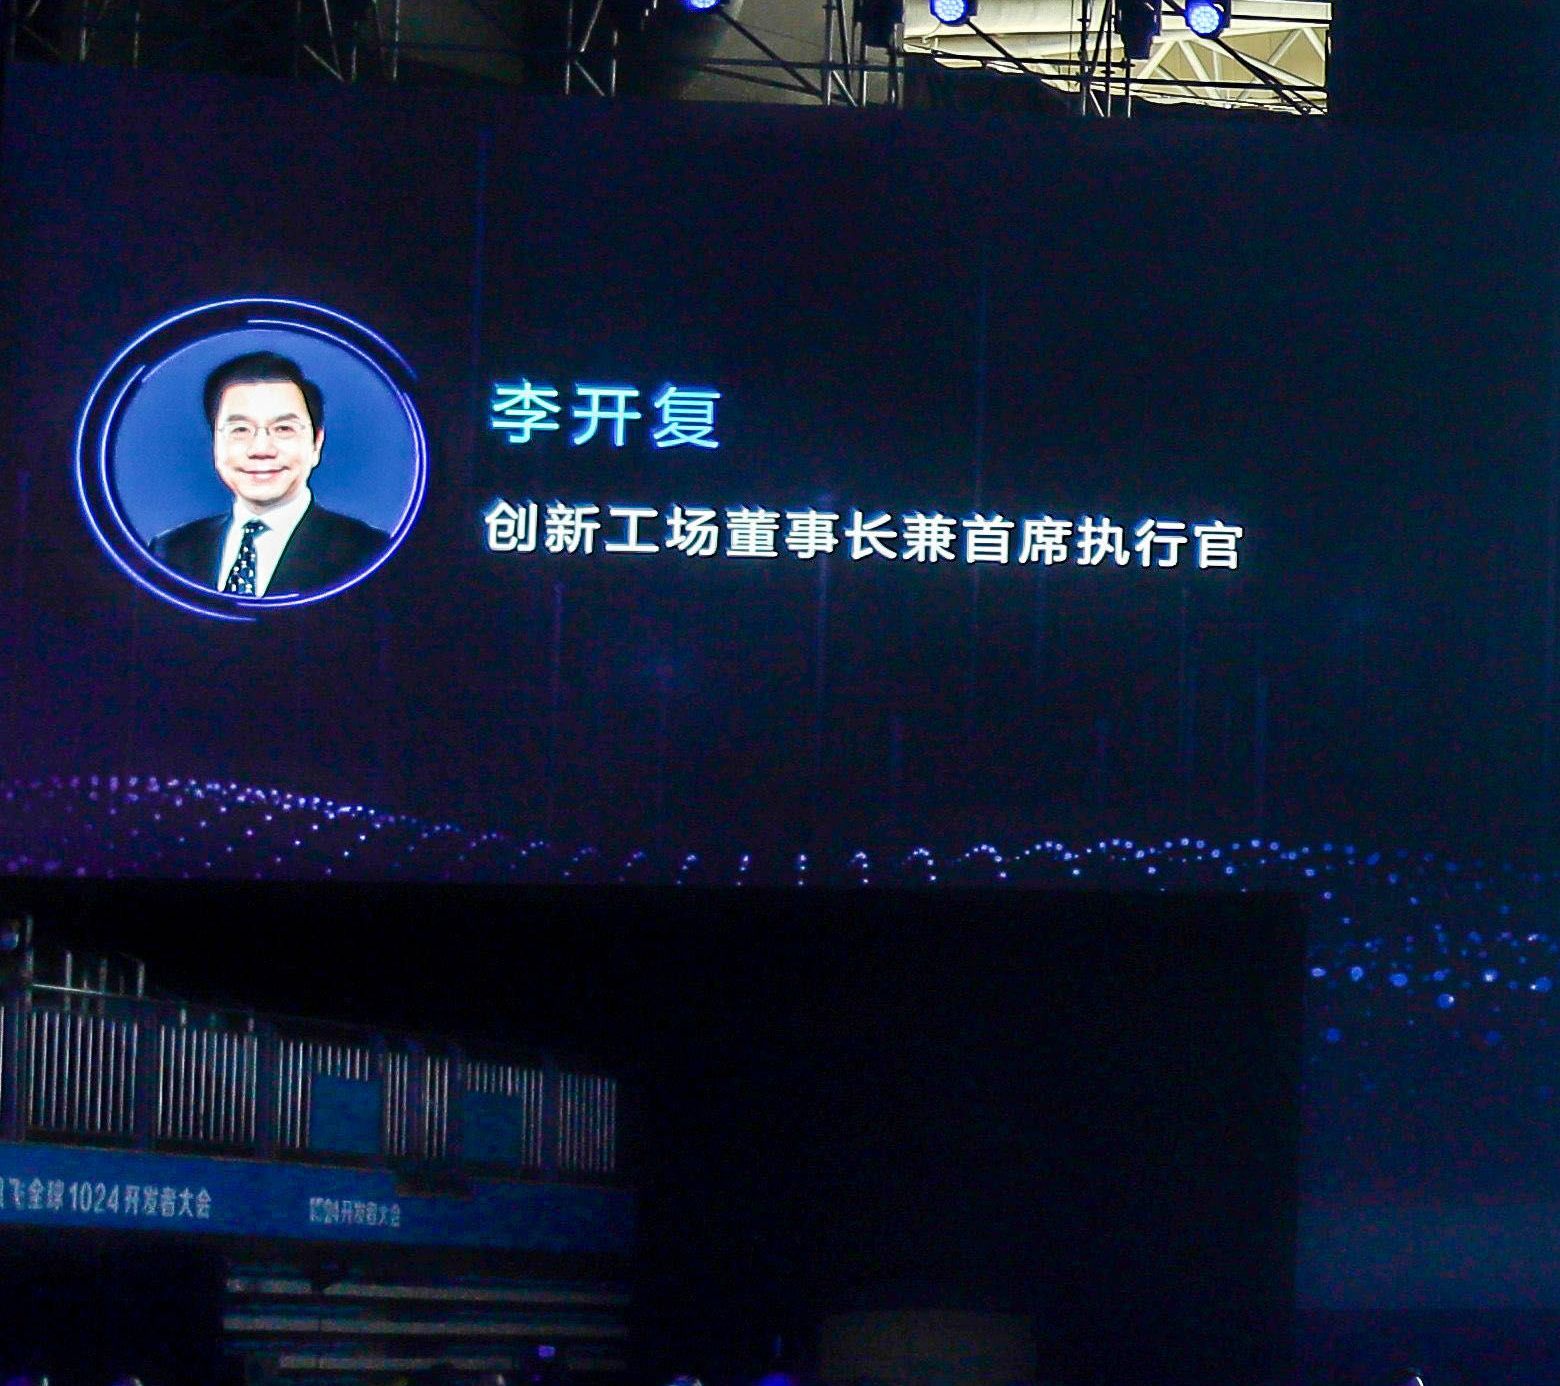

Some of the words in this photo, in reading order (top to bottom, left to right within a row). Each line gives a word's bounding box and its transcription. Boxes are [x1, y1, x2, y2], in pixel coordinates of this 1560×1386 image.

[490, 378, 722, 451] 李开复
[483, 498, 1245, 571] 创新工场董事长兼首席执行官
[0, 1175, 212, 1219] 飞全球1024开发者大会
